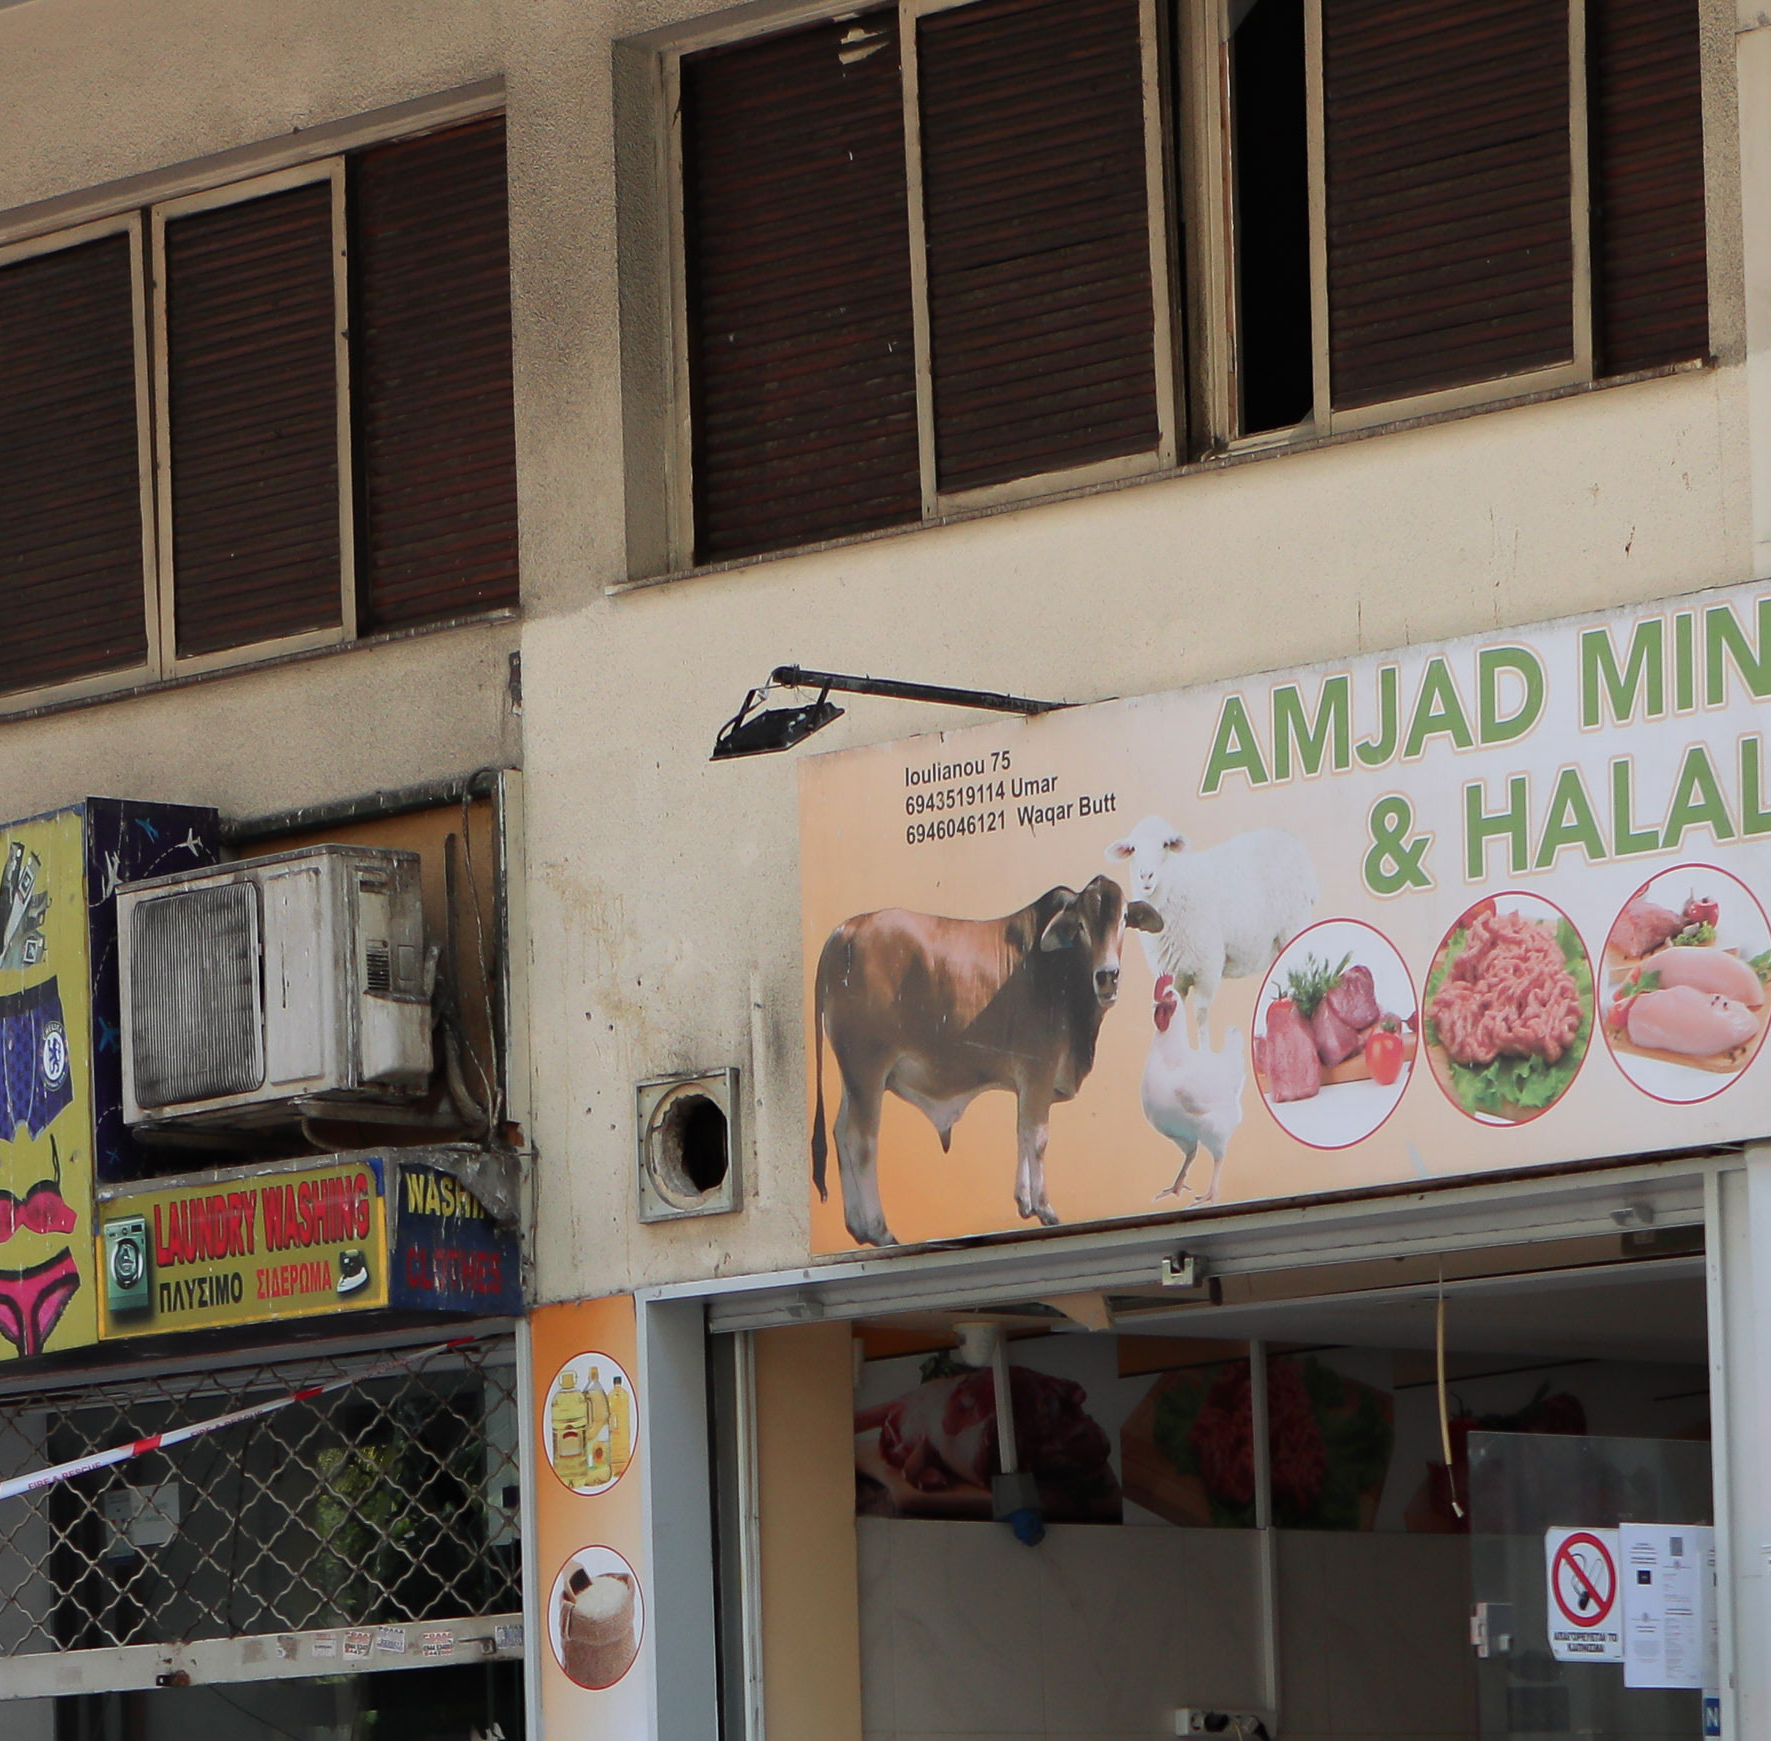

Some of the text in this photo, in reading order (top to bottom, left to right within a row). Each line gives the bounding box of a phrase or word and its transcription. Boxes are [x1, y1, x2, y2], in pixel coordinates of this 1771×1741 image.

[1199, 645, 1546, 795] AMJAD
[990, 750, 1011, 772] 75
[905, 775, 1058, 816] 6943519114 Umar
[906, 792, 1117, 845] 6946046121 Waqar Butt
[1364, 796, 1433, 894] &
[153, 1172, 371, 1268] LAUNDRY WASHING
[404, 1172, 486, 1220] WASHI
[159, 1260, 333, 1313] ΠΛΥΣΙΜΟ ΣΙΔΕΡΩΜΑ
